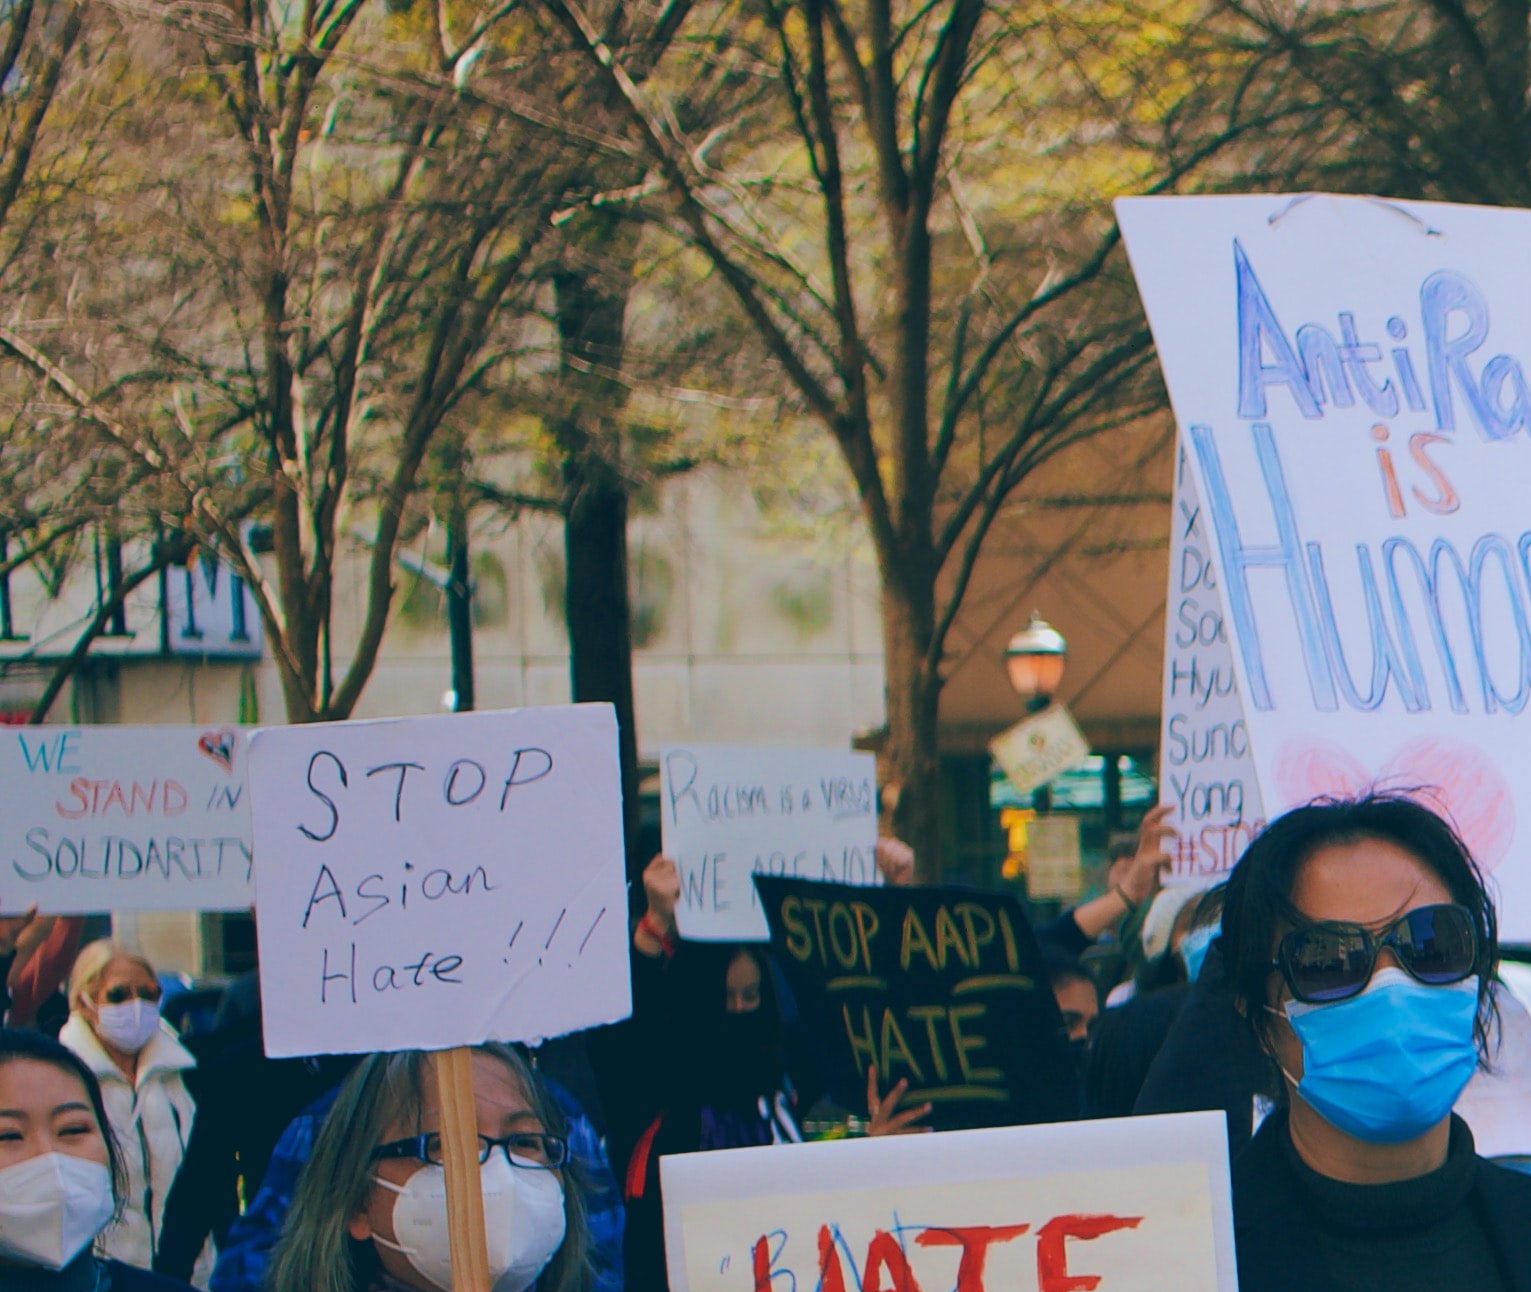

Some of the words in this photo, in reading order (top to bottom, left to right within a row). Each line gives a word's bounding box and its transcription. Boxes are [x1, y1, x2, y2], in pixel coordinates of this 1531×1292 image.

[1374, 424, 1460, 518] is
[1171, 656, 1237, 710] Hyu
[18, 732, 82, 773] WE
[56, 777, 188, 819] STAND
[206, 784, 242, 811] IN
[297, 748, 553, 842] STOP
[665, 749, 768, 826] Racism
[780, 783, 794, 814] is
[12, 826, 254, 882] SOLIDARITY
[679, 852, 731, 912] WE
[303, 863, 499, 928] Asian
[782, 897, 879, 974] STOP
[902, 901, 1019, 973] AAPI
[320, 943, 464, 1003] Hate
[843, 1003, 1004, 1082] HATE
